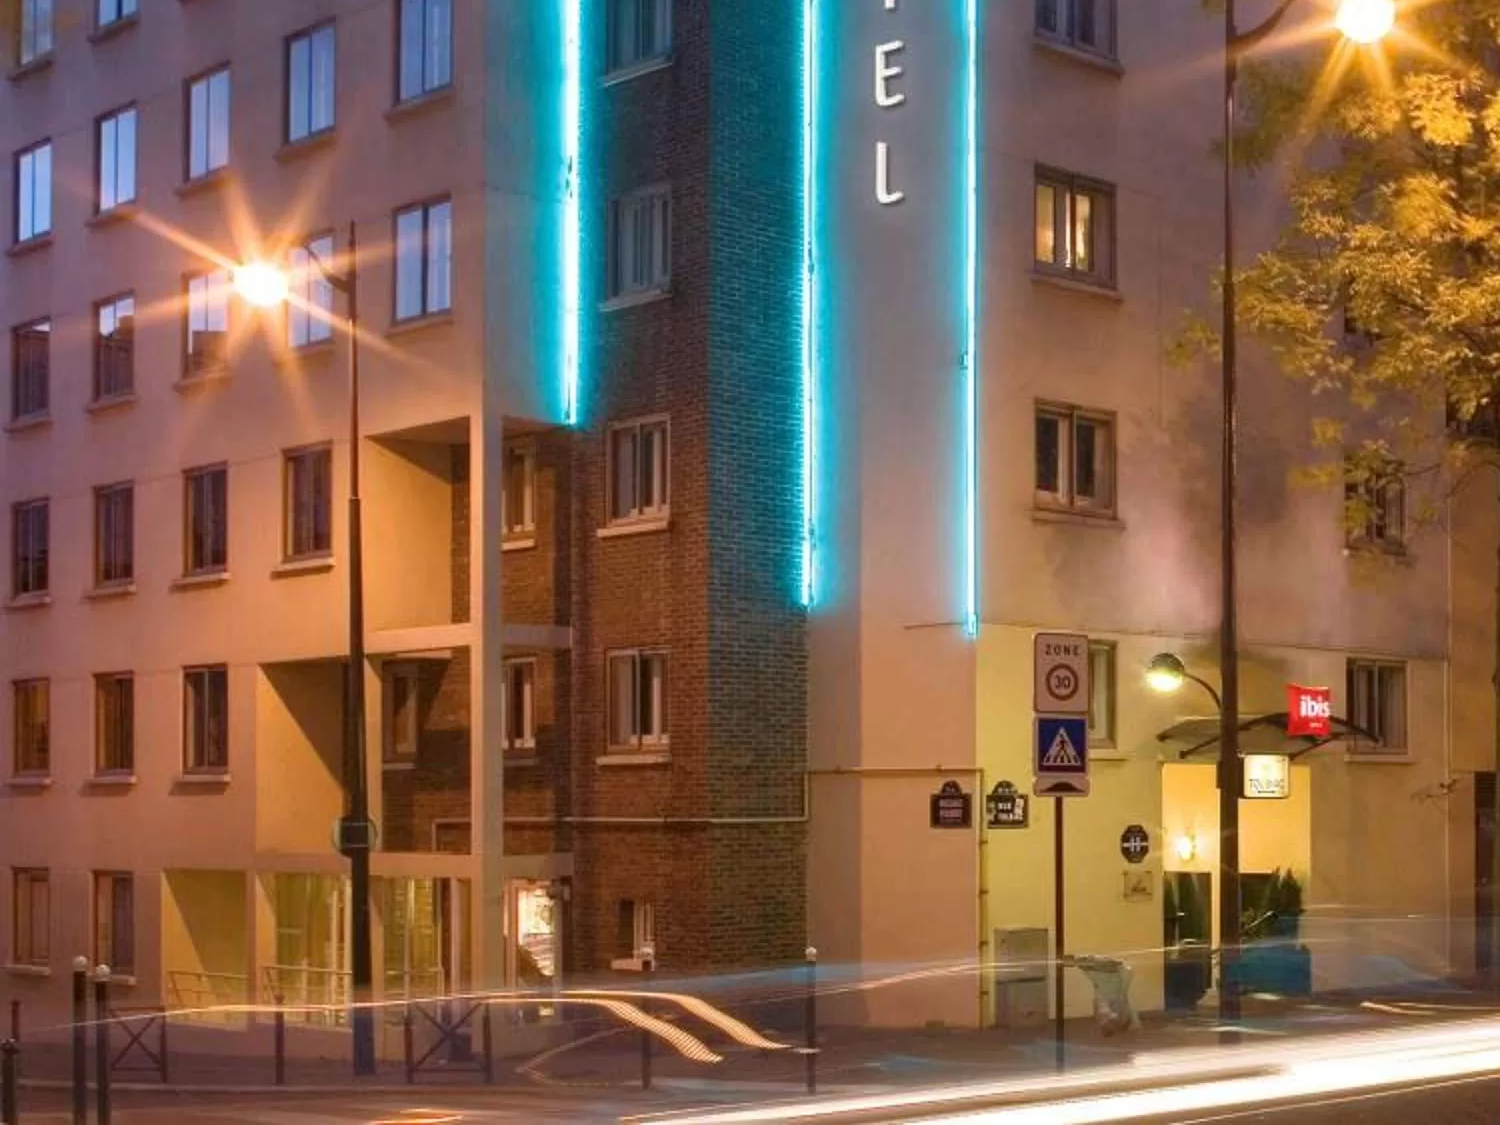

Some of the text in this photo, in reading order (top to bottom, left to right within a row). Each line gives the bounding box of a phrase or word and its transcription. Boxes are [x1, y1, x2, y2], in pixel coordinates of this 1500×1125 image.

[1045, 643, 1080, 656] ZONE
[1055, 674, 1071, 690] 30
[1300, 695, 1330, 718] ibis
